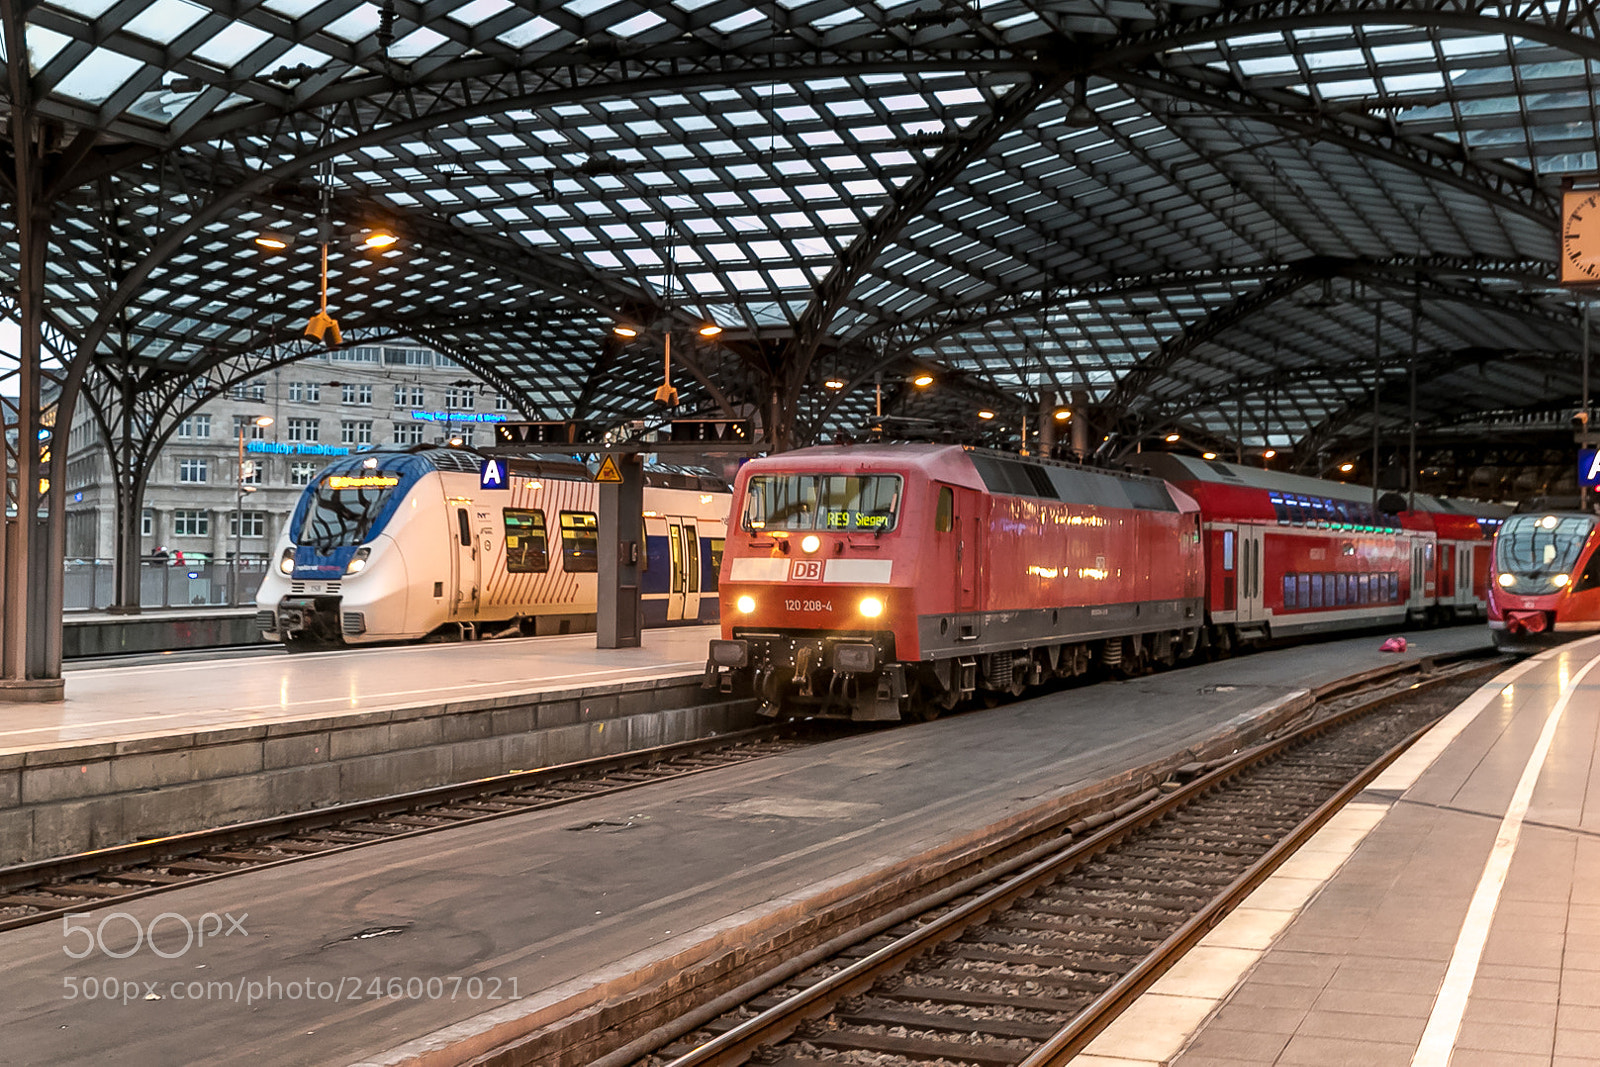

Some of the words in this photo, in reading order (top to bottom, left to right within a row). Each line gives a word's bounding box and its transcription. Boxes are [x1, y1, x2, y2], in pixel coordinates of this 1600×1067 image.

[483, 459, 501, 484] A
[827, 511, 850, 527] RE9
[855, 511, 889, 527] Siegen
[794, 562, 819, 578] DB
[785, 599, 801, 611] 120
[802, 600, 833, 612] 208-4
